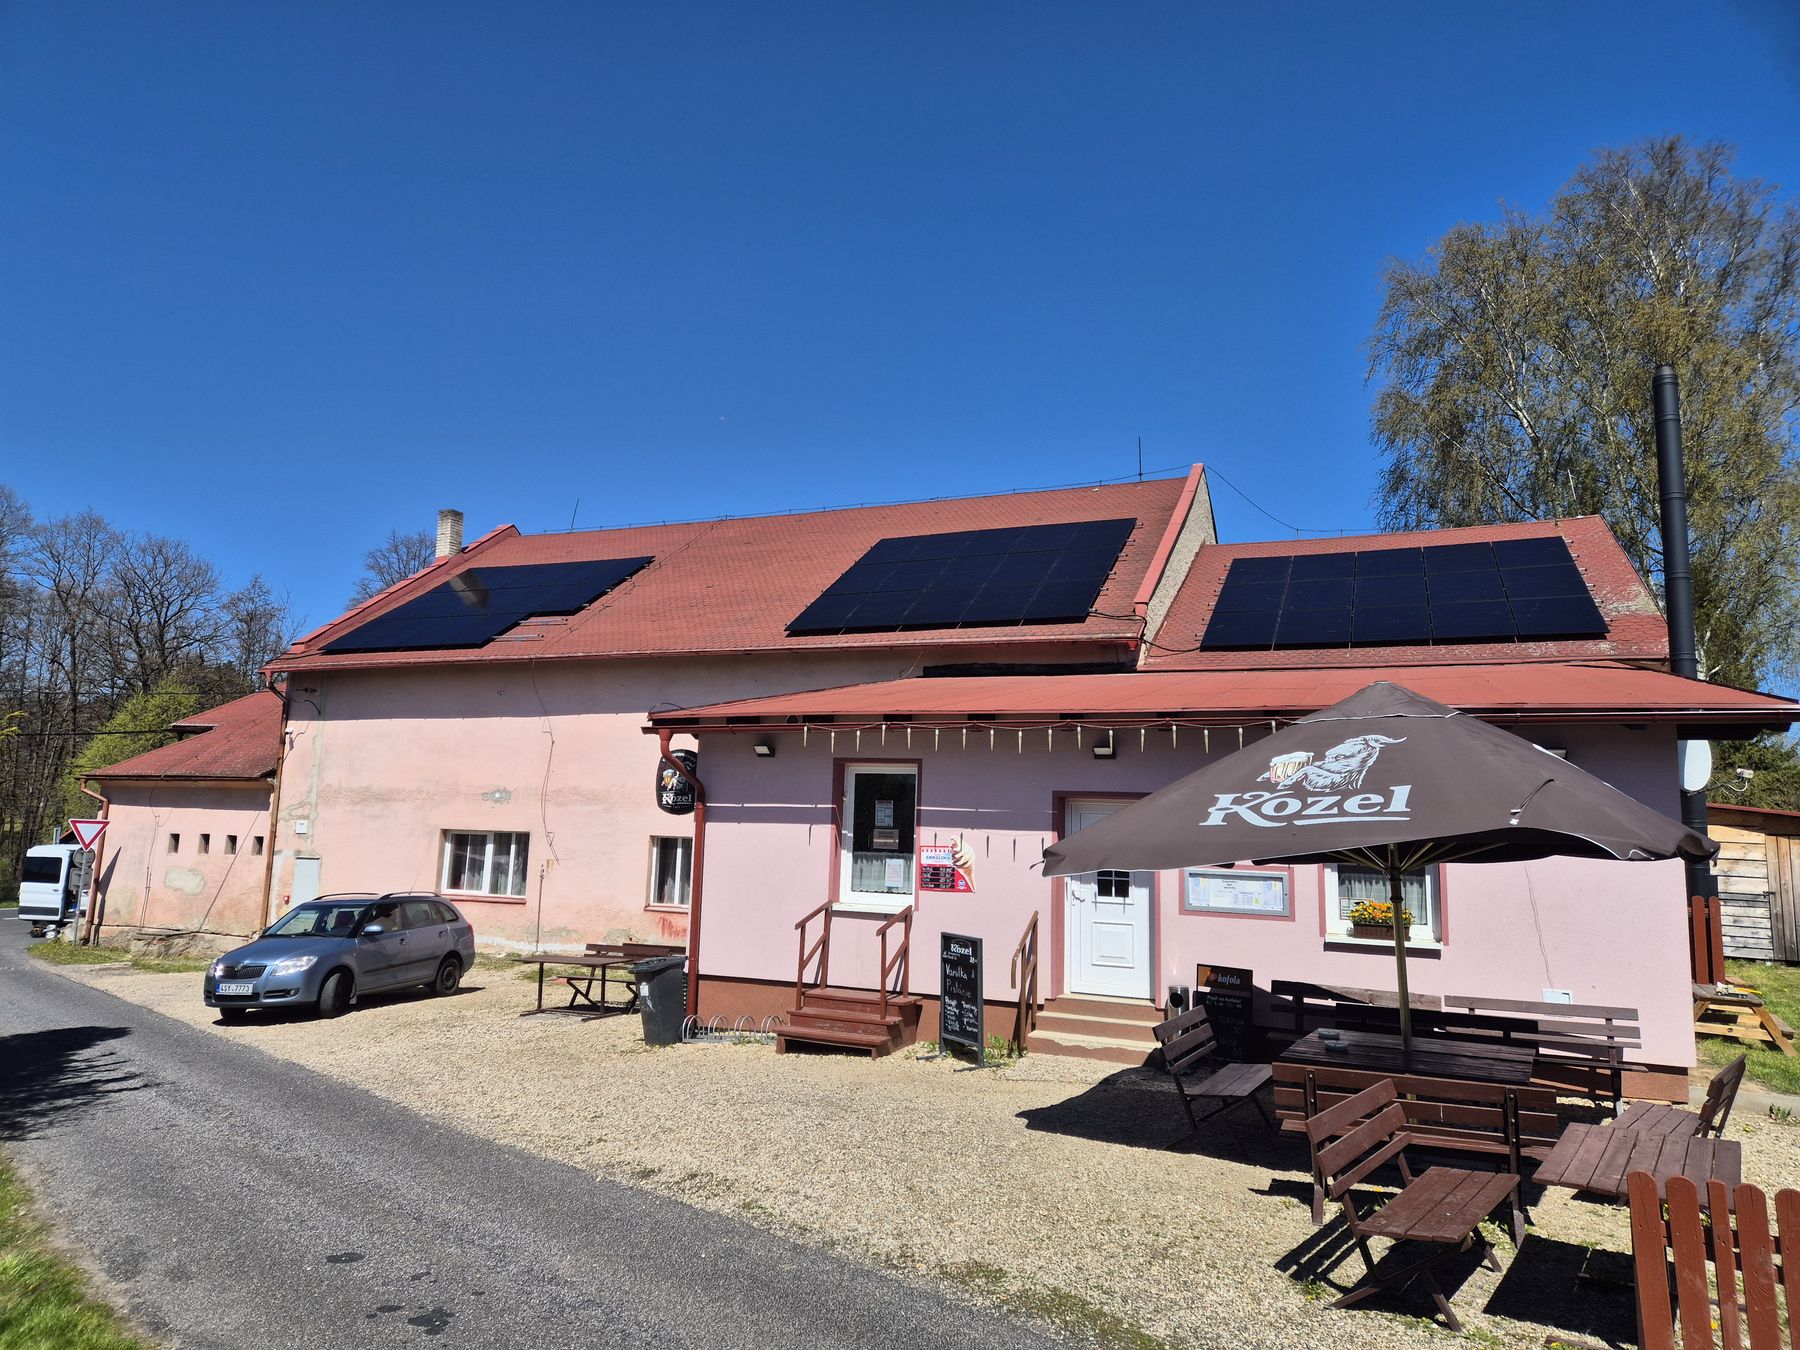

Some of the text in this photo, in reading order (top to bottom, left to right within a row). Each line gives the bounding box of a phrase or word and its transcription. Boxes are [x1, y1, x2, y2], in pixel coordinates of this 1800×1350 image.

[661, 792, 692, 805] Kozel
[1199, 785, 1412, 828] Kozel
[950, 943, 972, 956] Kozel
[1217, 973, 1240, 985] kofola
